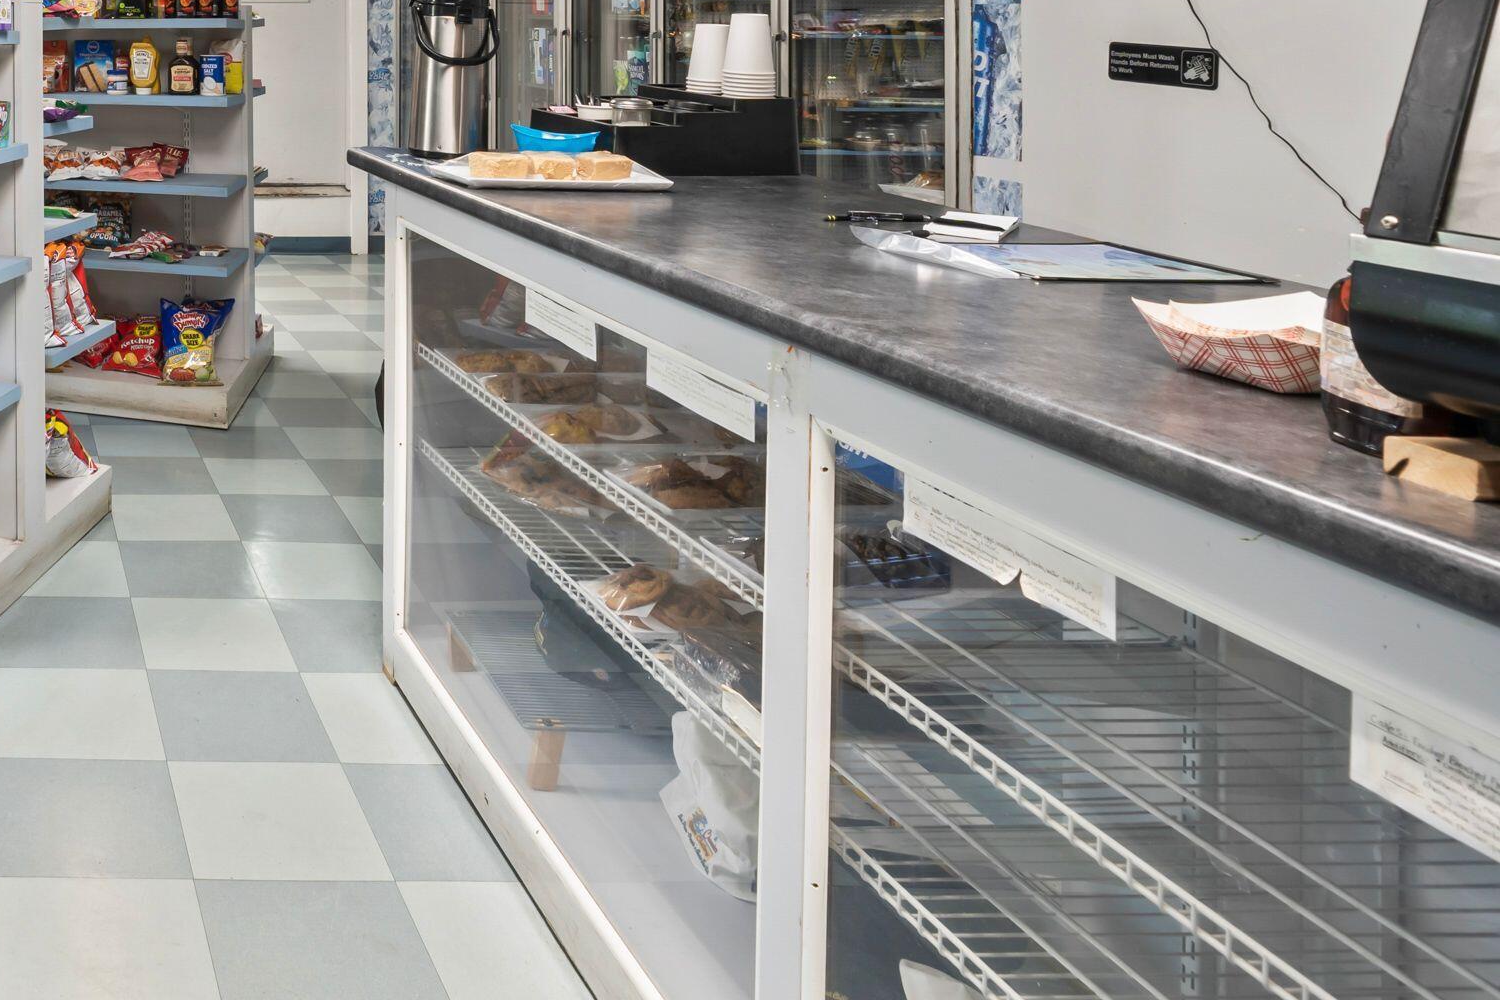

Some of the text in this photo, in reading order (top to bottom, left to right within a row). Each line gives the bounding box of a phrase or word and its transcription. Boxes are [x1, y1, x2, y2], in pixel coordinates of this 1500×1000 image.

[1143, 52, 1157, 60] Must
[1149, 62, 1179, 71] Returning
[88, 231, 119, 242] OPCORN
[173, 317, 206, 332] Dumpty
[120, 337, 155, 350] Ketchup
